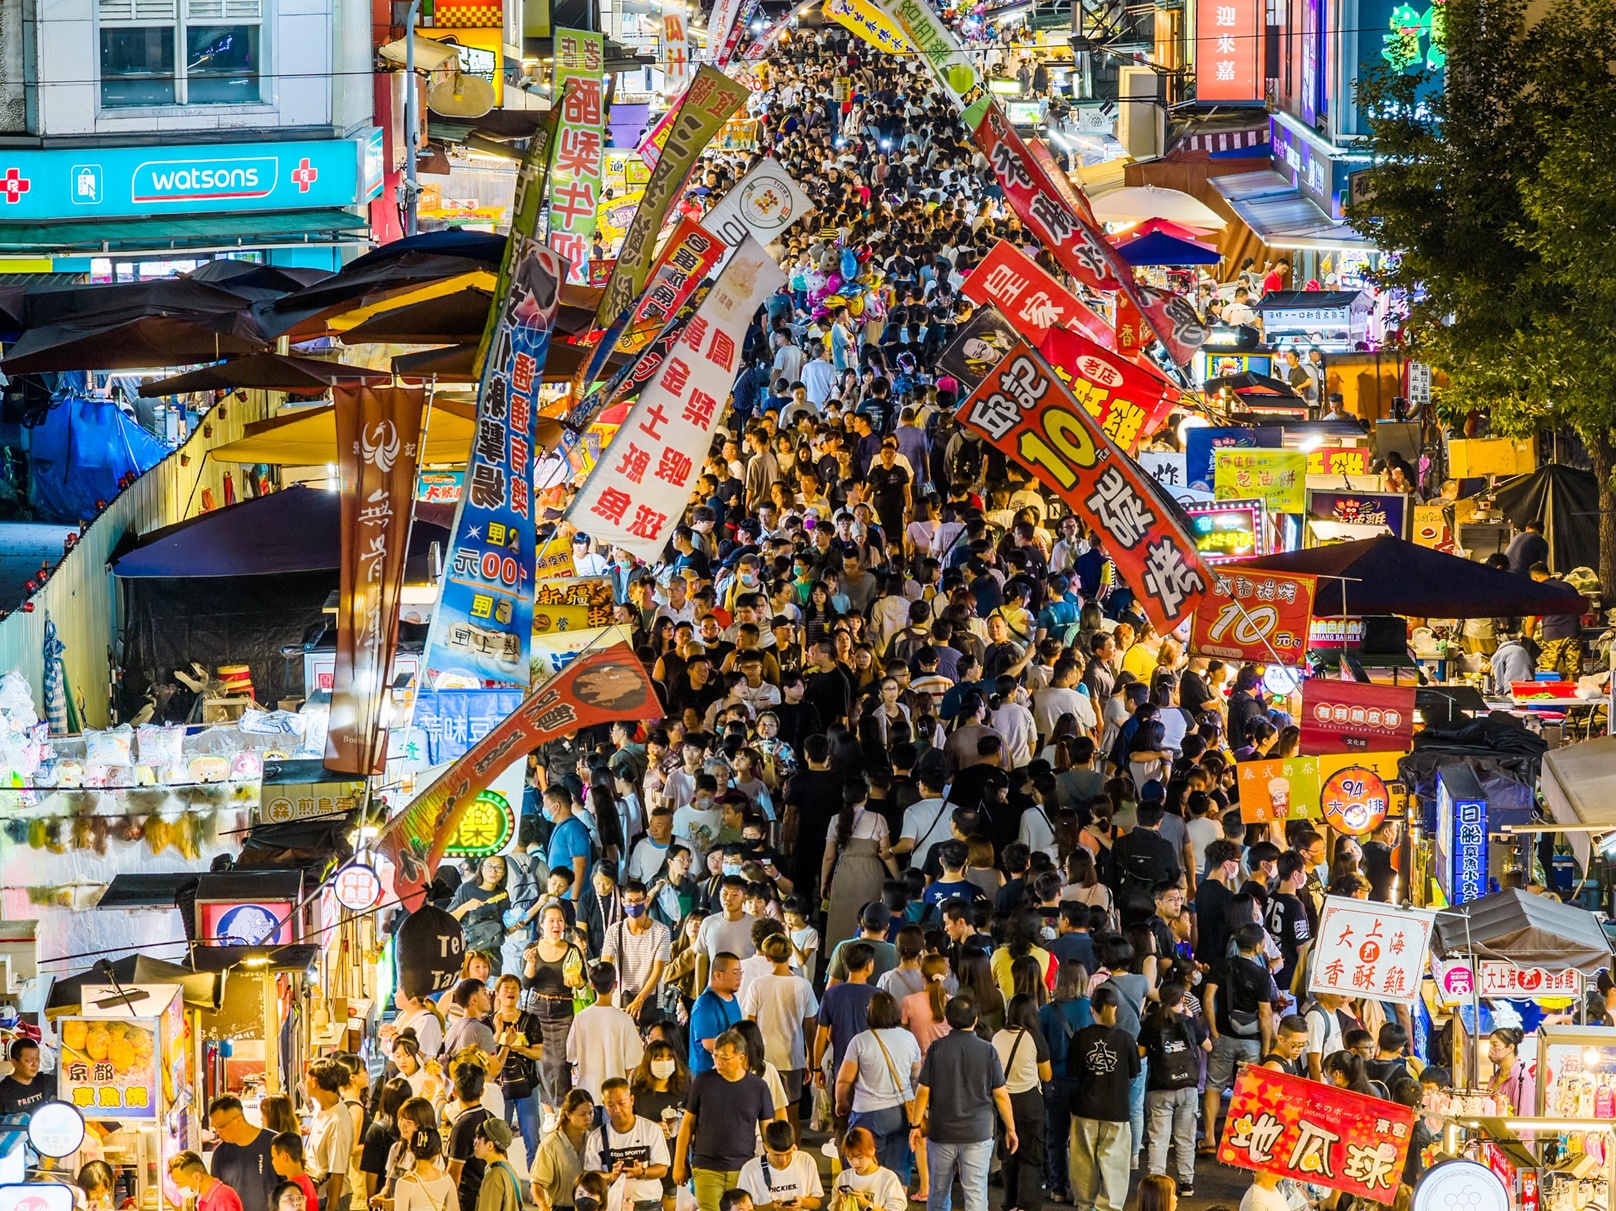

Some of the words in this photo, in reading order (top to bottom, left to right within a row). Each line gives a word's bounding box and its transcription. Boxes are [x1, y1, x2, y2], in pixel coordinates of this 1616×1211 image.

[664, 15, 686, 76] 瓜汁
[1216, 6, 1236, 81] 迎來嘉
[152, 167, 259, 191] watsons
[1083, 356, 1118, 386] 老店
[968, 358, 1048, 442] 邱記
[1153, 462, 1178, 484] 炸
[539, 584, 590, 605] 新疆
[588, 606, 607, 628] 串
[1242, 761, 1315, 781] 泰式奶茶
[1342, 779, 1368, 801] 94
[274, 801, 290, 819] 森
[1336, 918, 1406, 955] 大上海
[1324, 958, 1406, 996] 香酥雞
[1487, 968, 1516, 990] 大上海
[70, 1064, 113, 1081] 京都
[17, 1092, 43, 1106] PRETTY
[72, 1086, 148, 1108] 章魚燒
[1375, 1117, 1408, 1139] 素食
[1230, 1112, 1397, 1190] 地瓜球
